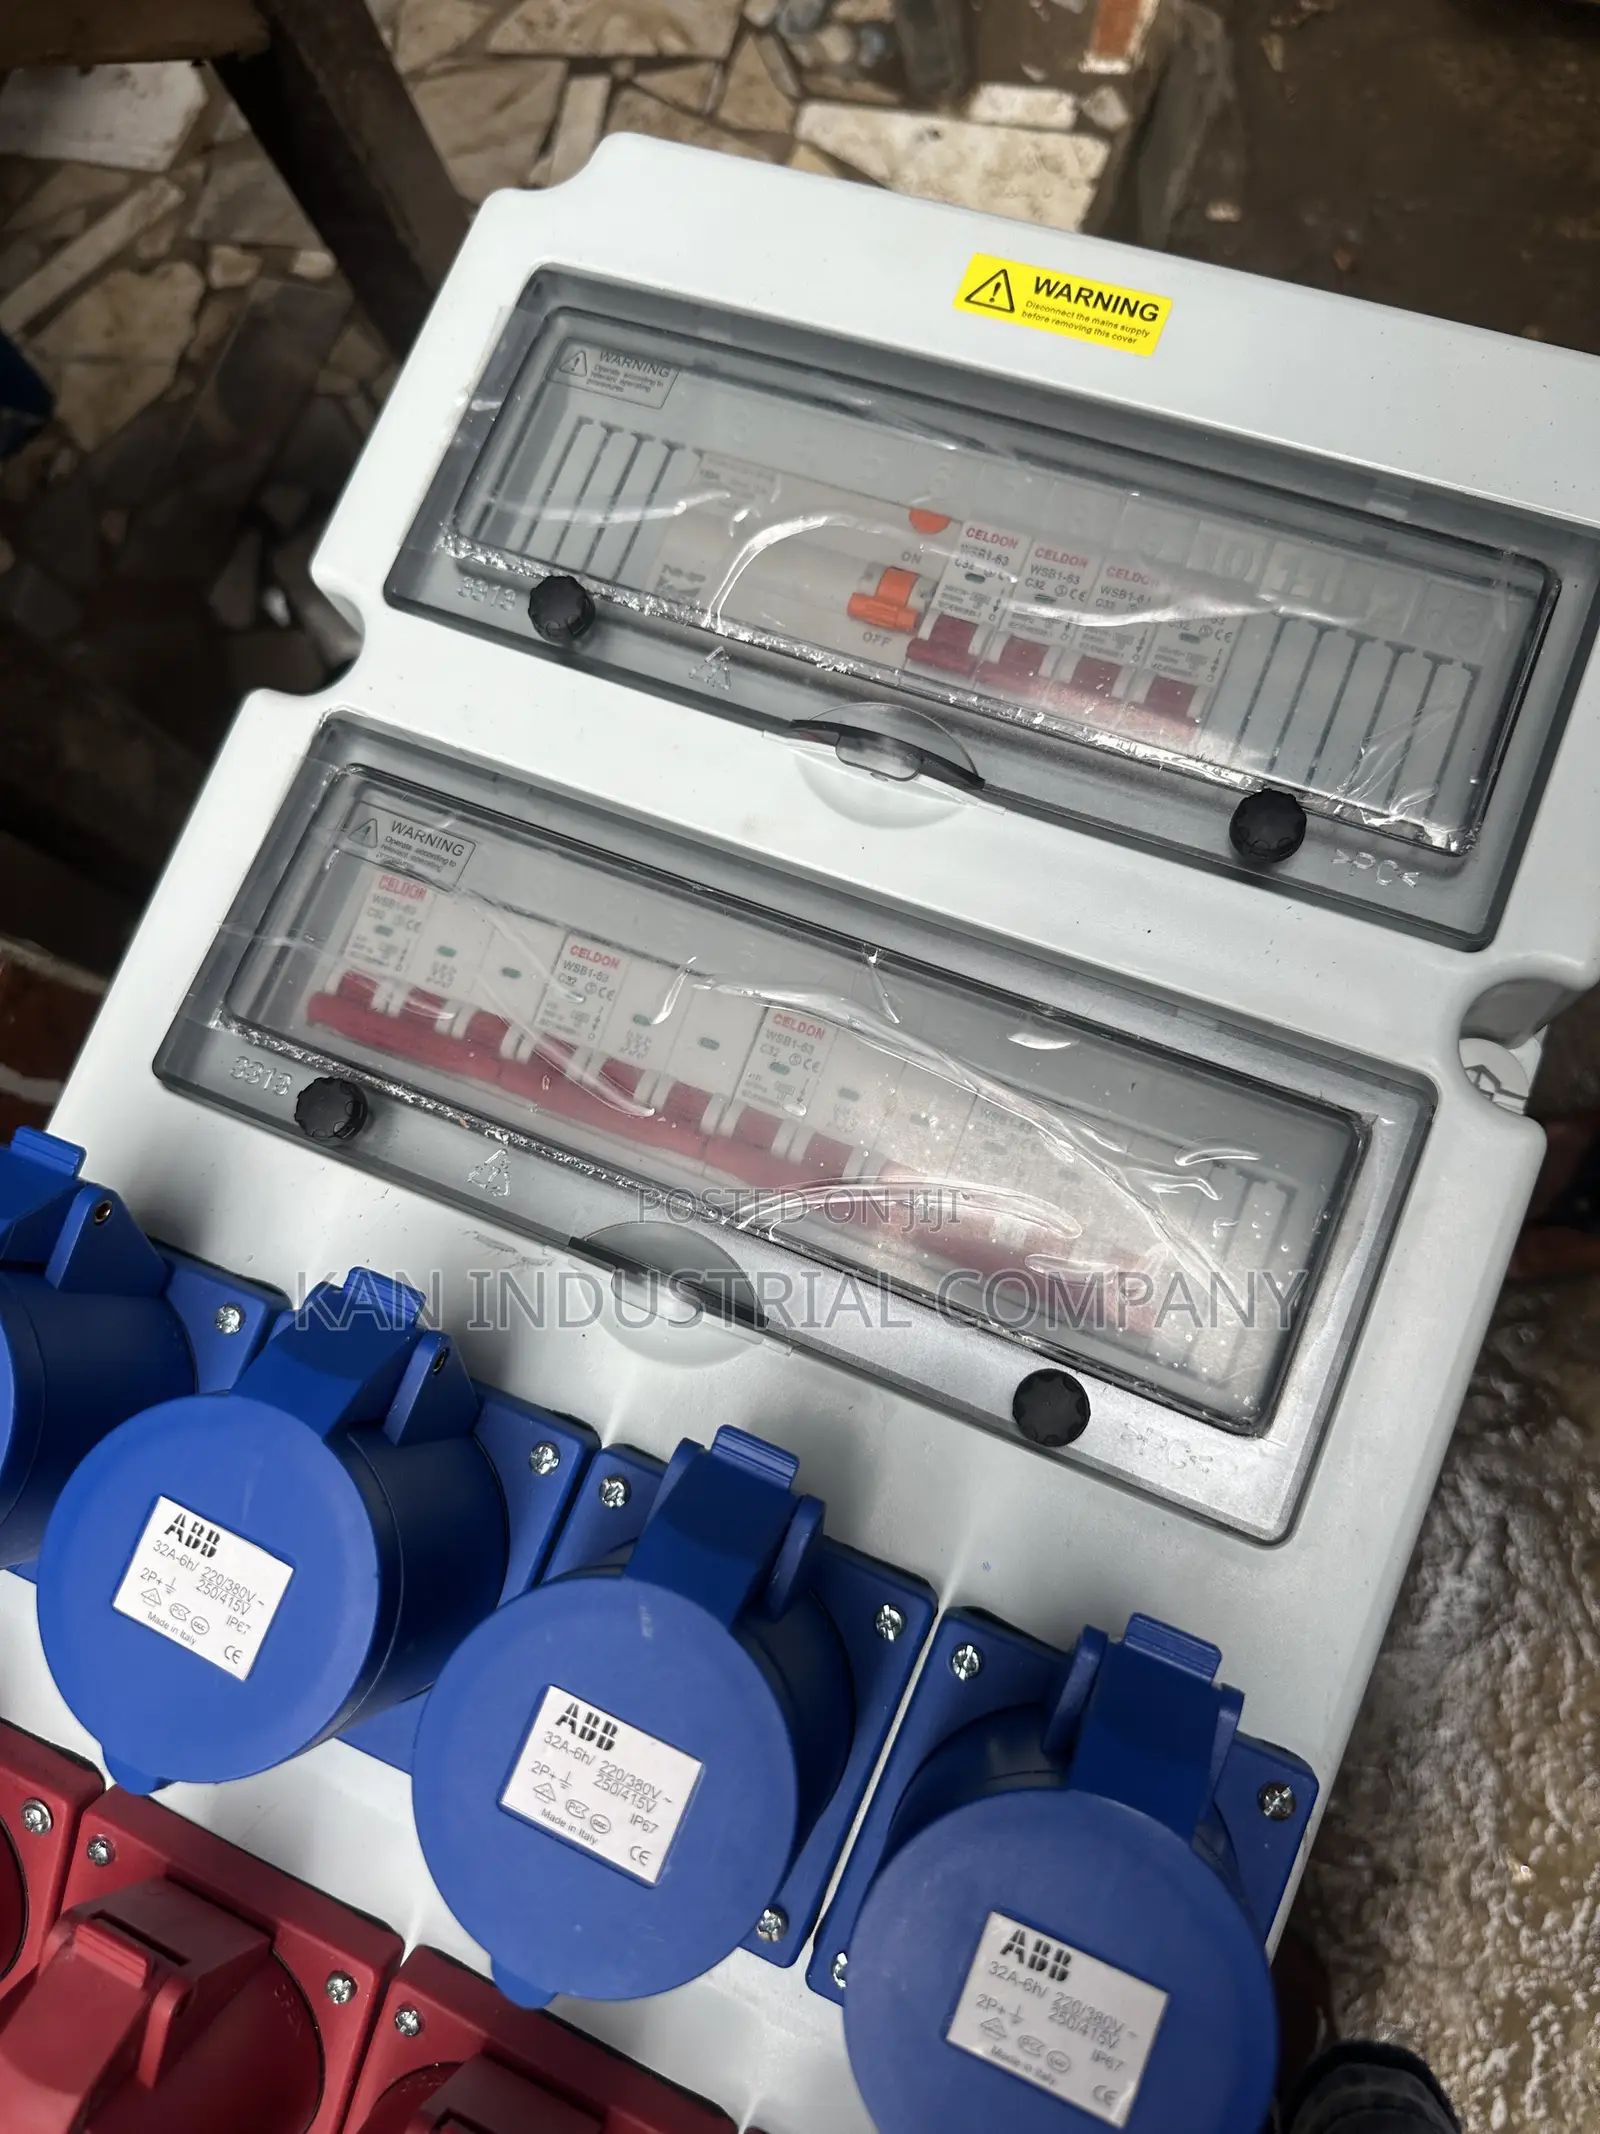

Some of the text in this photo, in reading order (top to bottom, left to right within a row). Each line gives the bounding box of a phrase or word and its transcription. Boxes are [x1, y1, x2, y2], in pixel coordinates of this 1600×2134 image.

[1034, 276, 1160, 322] WARNING
[1021, 310, 1138, 344] before removing this cover
[1025, 300, 1150, 338] Disconnect the mains supply
[600, 351, 670, 378] WARNING
[966, 527, 1019, 549] CELDON
[901, 551, 922, 565] ON
[1034, 547, 1089, 568] CELDON
[862, 631, 892, 647] OFF
[391, 820, 465, 856] WARNING
[378, 874, 429, 901] CELDON
[570, 944, 621, 970] CELDON
[772, 1013, 826, 1041] CELDON
[764, 1028, 815, 1056] WSB1-63
[164, 1513, 221, 1558] ABB
[153, 1540, 257, 1602] 32A-6h/ 220/380V
[196, 1579, 251, 1616] 250/415V
[147, 1611, 197, 1646] Made in Italy
[226, 1614, 251, 1635] IP67
[224, 1645, 243, 1664] CE
[555, 1702, 619, 1751] ABB
[531, 1761, 557, 1780] 2P+
[544, 1731, 663, 1800] 32A-6h/ 220/380V
[593, 1774, 658, 1814] 250/415V
[541, 1808, 598, 1846] Made in Italy
[630, 1813, 659, 1834] IP67
[630, 1845, 652, 1866] CE
[1000, 1928, 1072, 1982] ABB
[1092, 2084, 1118, 2107] CE
